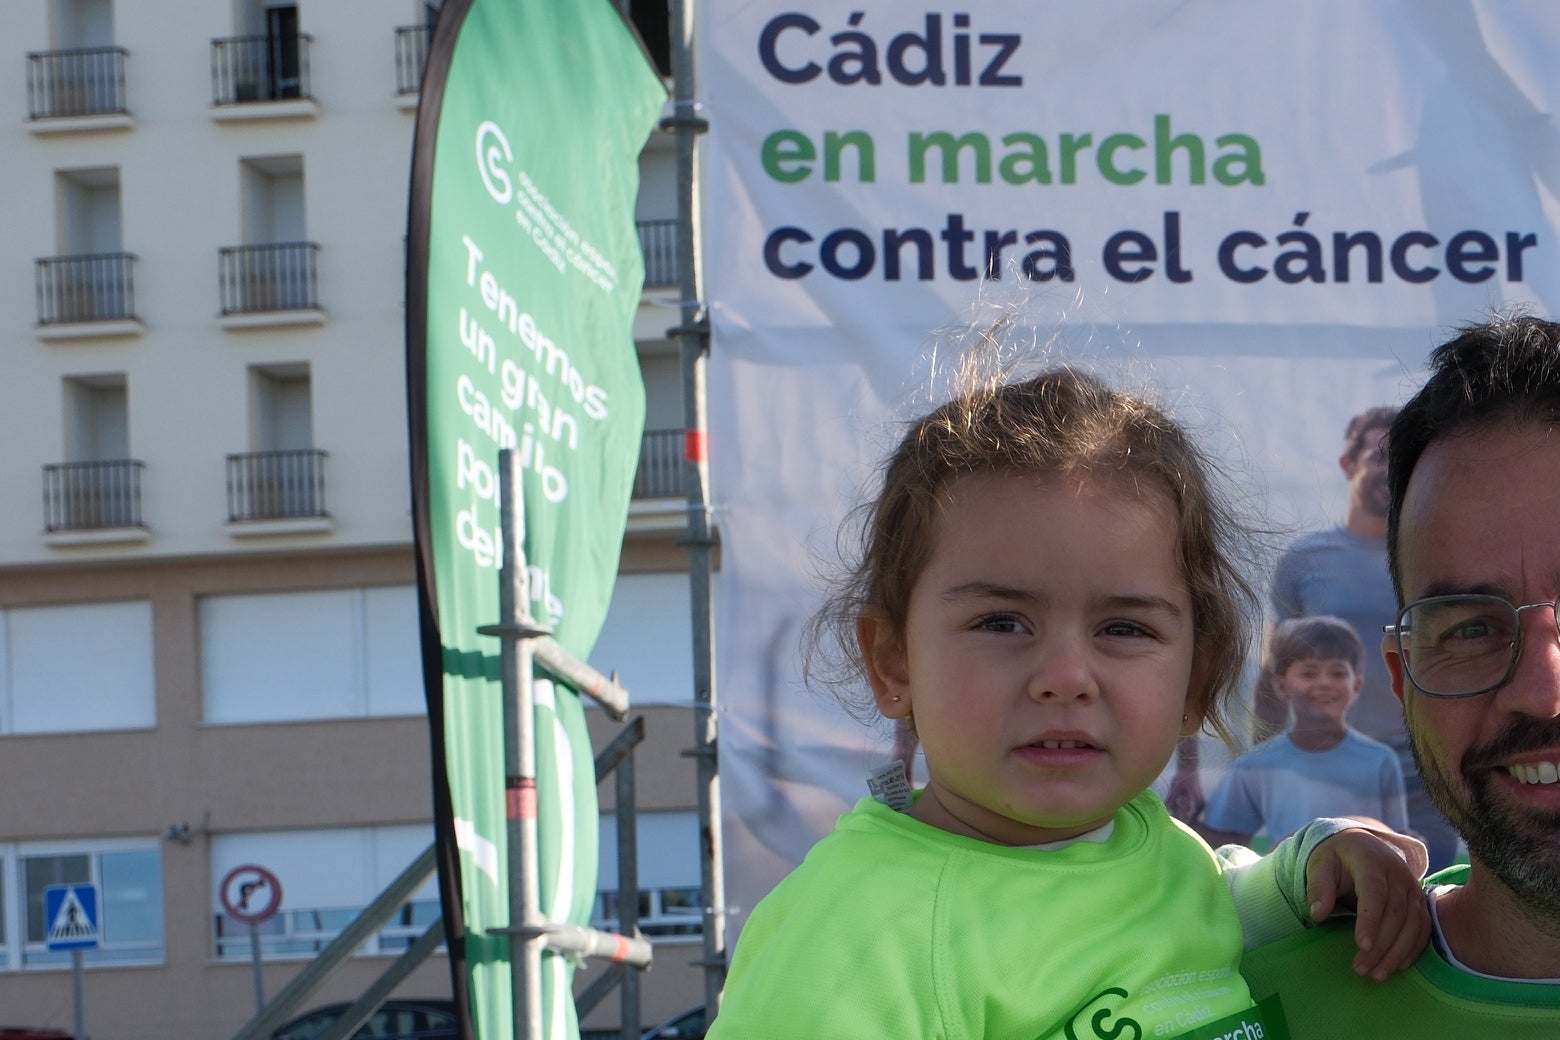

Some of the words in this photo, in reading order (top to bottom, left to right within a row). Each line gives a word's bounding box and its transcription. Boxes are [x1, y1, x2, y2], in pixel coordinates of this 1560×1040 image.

[758, 12, 1023, 87] Cádiz
[760, 128, 875, 184] en
[906, 115, 1266, 187] marcha
[763, 215, 1074, 283] contra
[1102, 212, 1190, 284] el
[1218, 212, 1539, 284] cáncer
[460, 308, 496, 375] un
